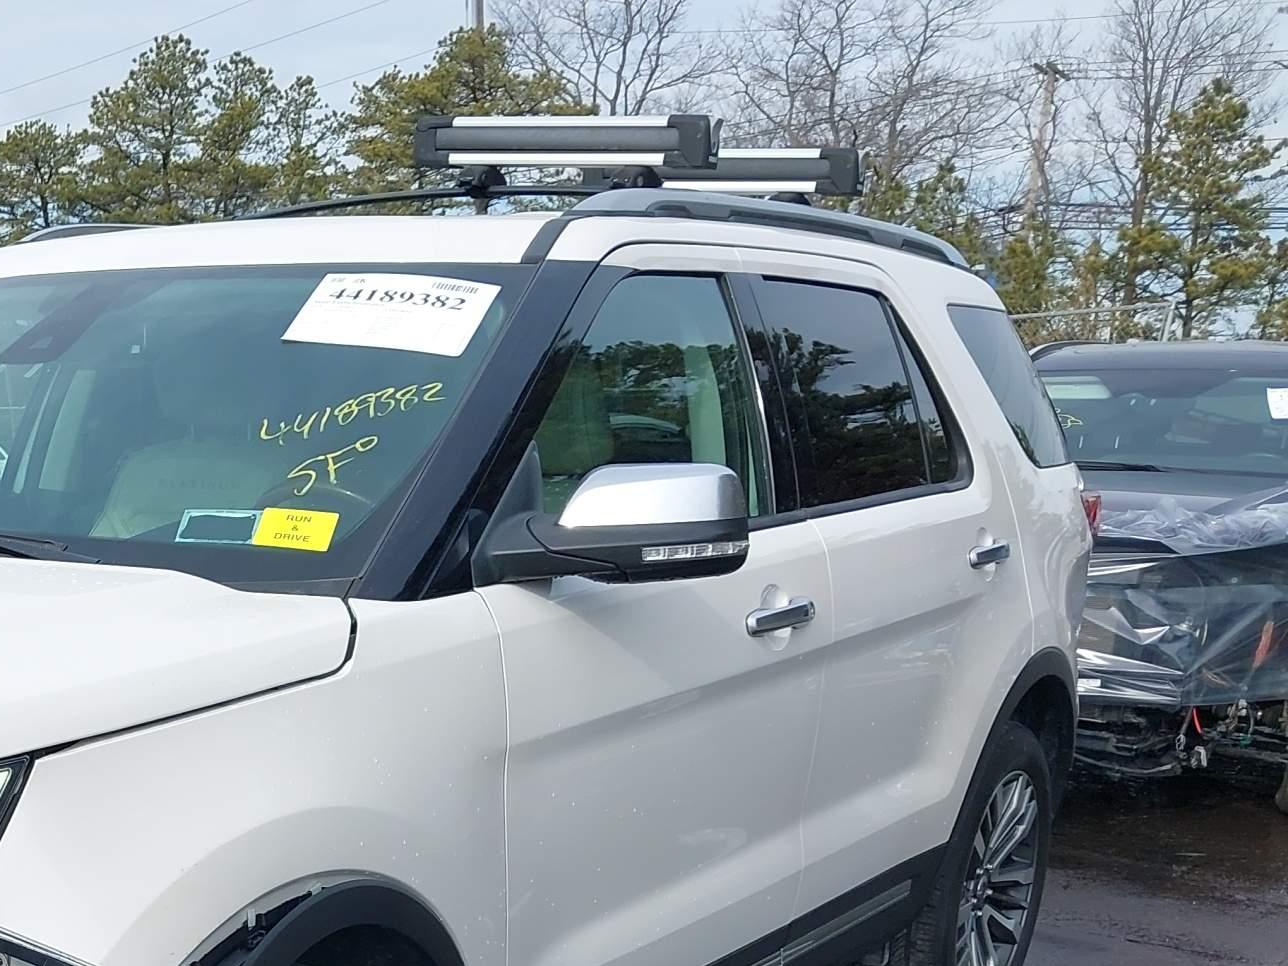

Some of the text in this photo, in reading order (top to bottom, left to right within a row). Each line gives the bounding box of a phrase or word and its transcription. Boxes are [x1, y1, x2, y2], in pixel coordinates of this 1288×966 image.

[329, 287, 467, 311] 44189382
[260, 382, 447, 446] 44189382
[286, 514, 312, 523] RUN
[291, 524, 299, 532] &
[273, 532, 311, 543] DRIVE
